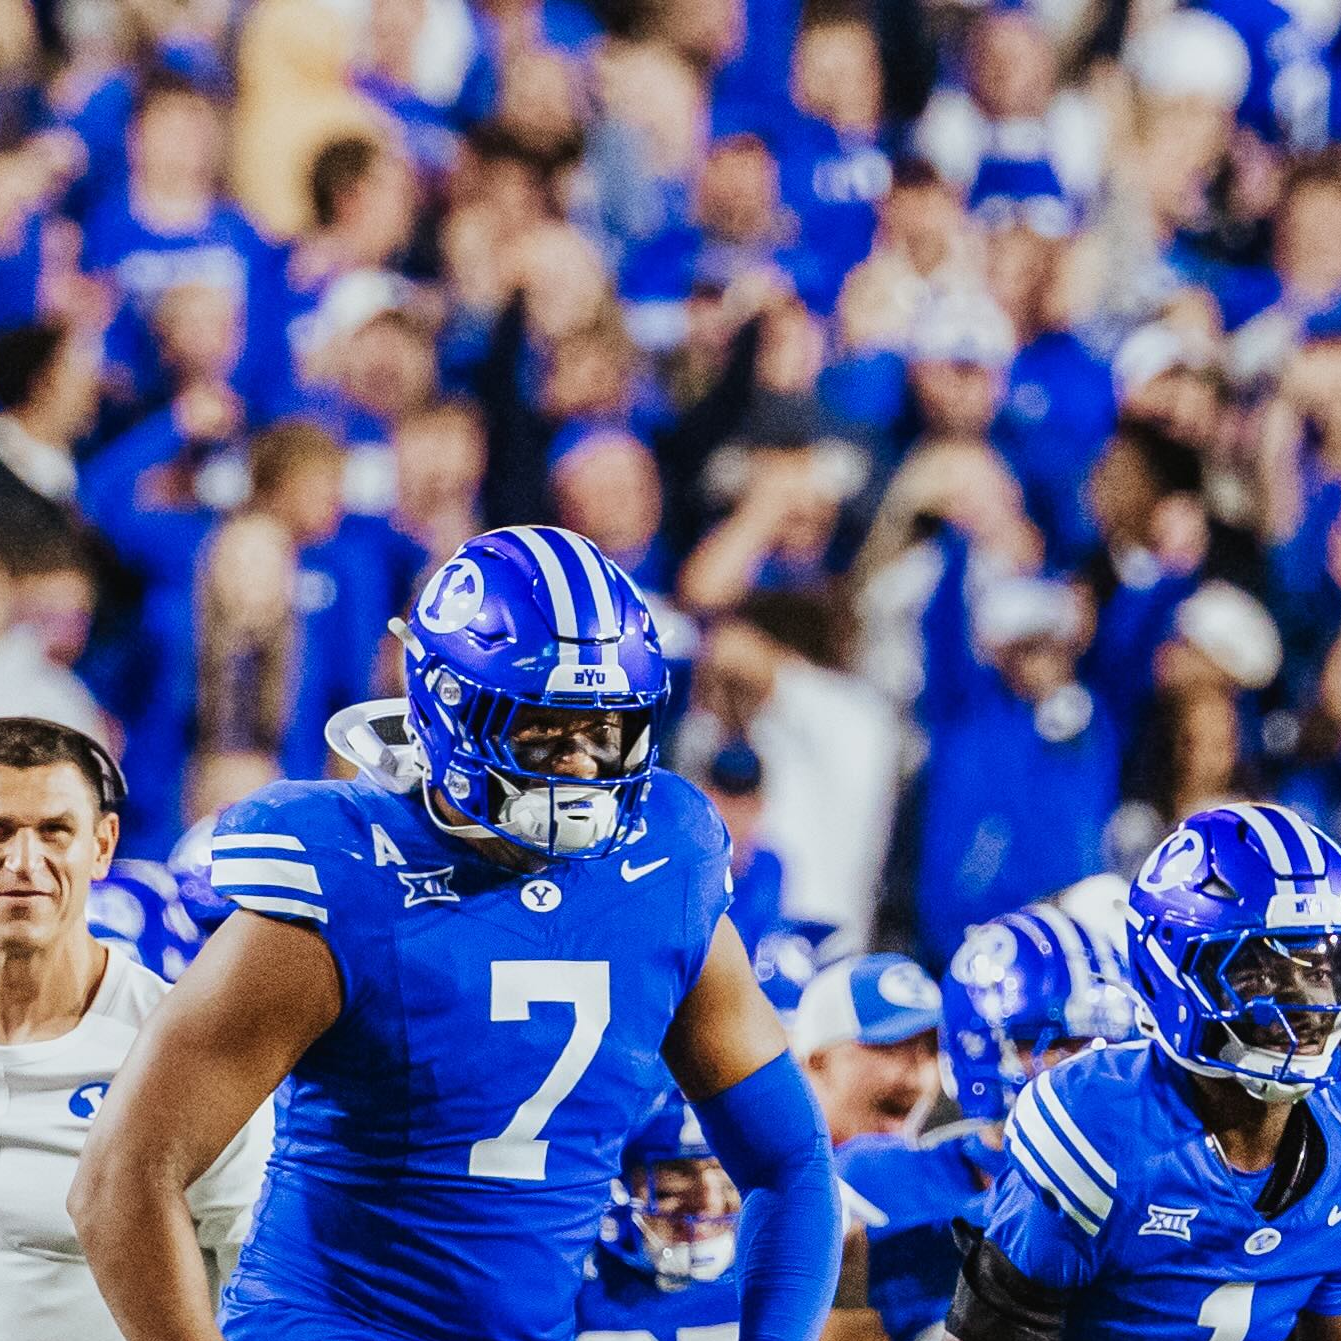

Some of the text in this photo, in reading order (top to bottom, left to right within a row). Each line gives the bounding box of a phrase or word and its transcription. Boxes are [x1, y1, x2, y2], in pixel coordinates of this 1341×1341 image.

[573, 668, 606, 687] BYU
[370, 823, 408, 867] A
[527, 885, 553, 907] Y
[468, 960, 611, 1181] 7
[1140, 1206, 1196, 1240] XII
